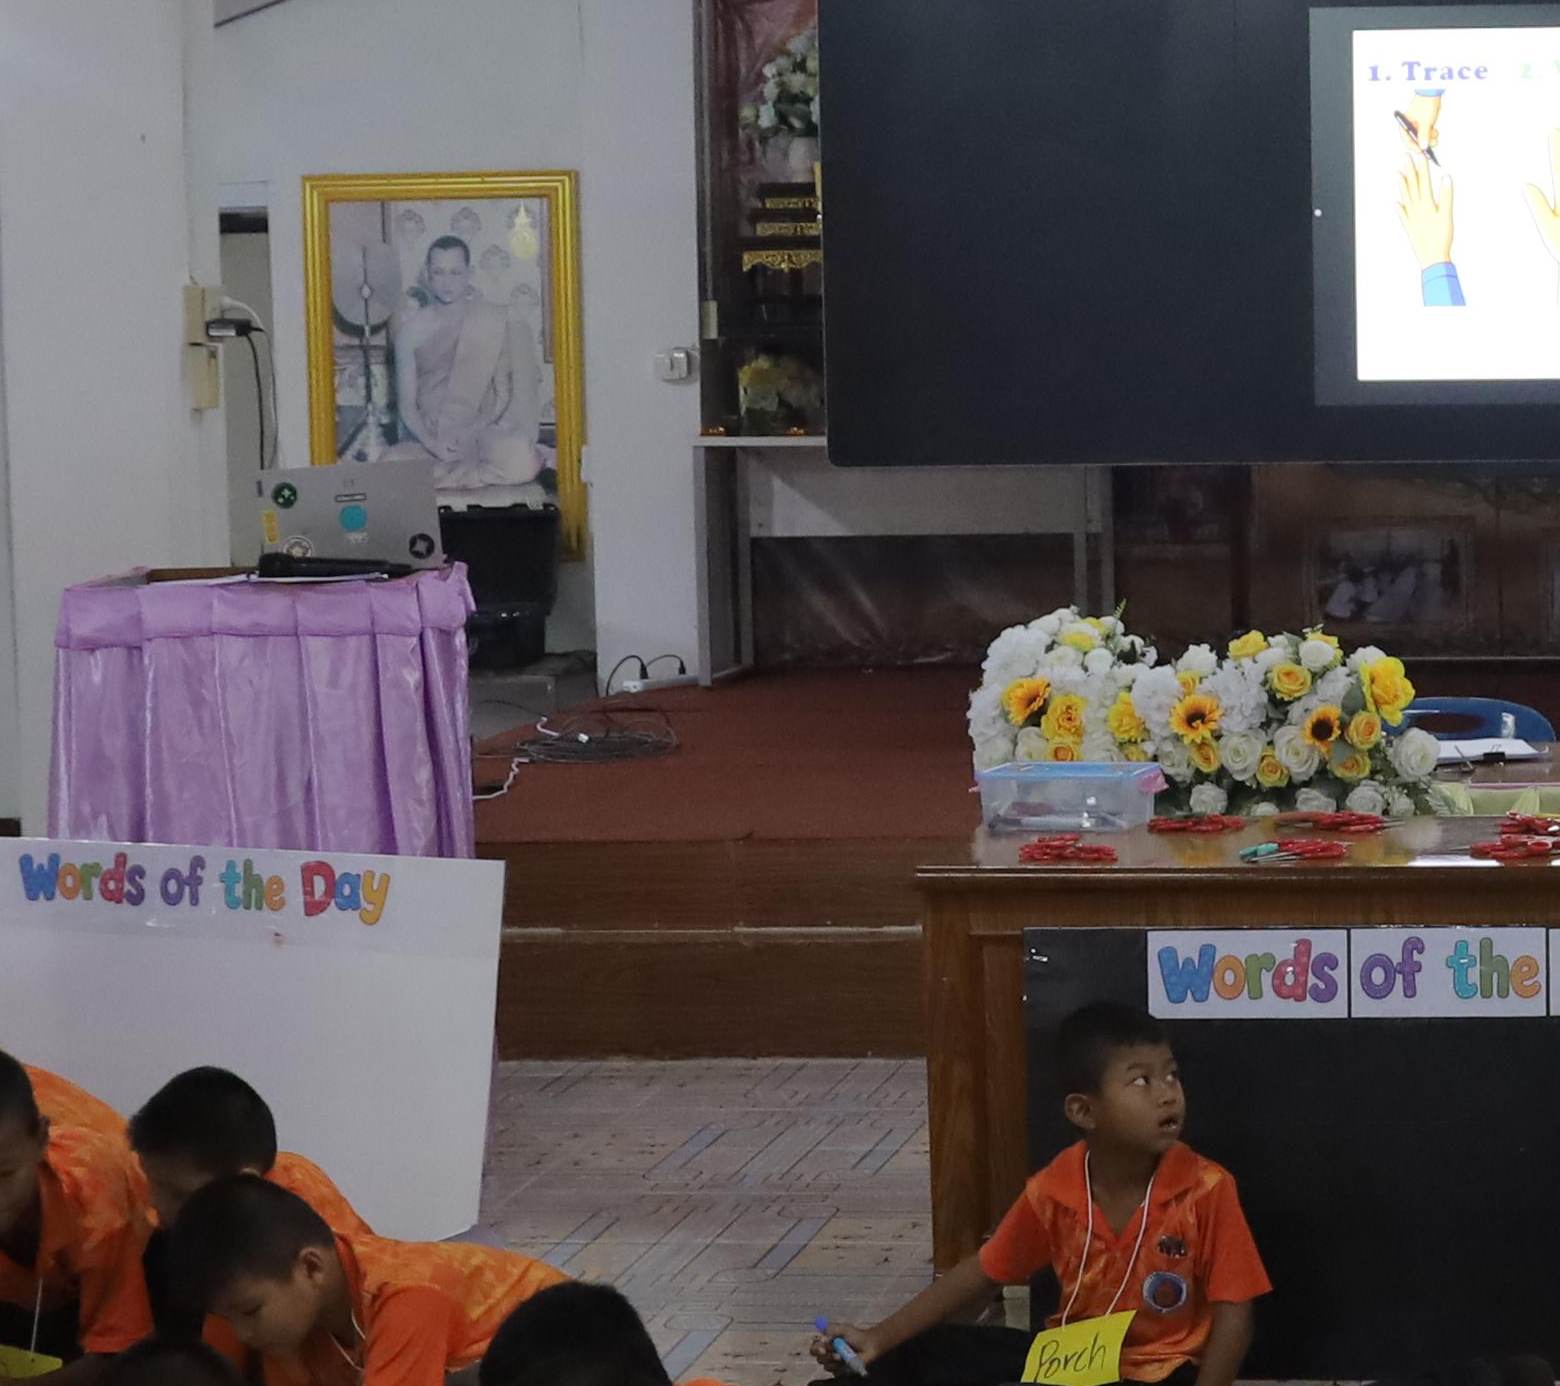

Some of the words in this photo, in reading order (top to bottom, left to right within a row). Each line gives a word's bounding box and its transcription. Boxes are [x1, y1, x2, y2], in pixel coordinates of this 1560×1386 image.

[1368, 64, 1392, 82] 1.
[1401, 61, 1489, 82] Trace
[18, 852, 146, 906] Words
[160, 854, 206, 906] of
[219, 858, 287, 911] the
[300, 859, 391, 926] Day
[1157, 938, 1339, 1004] Words
[1360, 936, 1425, 999] of
[1446, 937, 1541, 999] the
[1034, 1331, 1106, 1383] Porch
